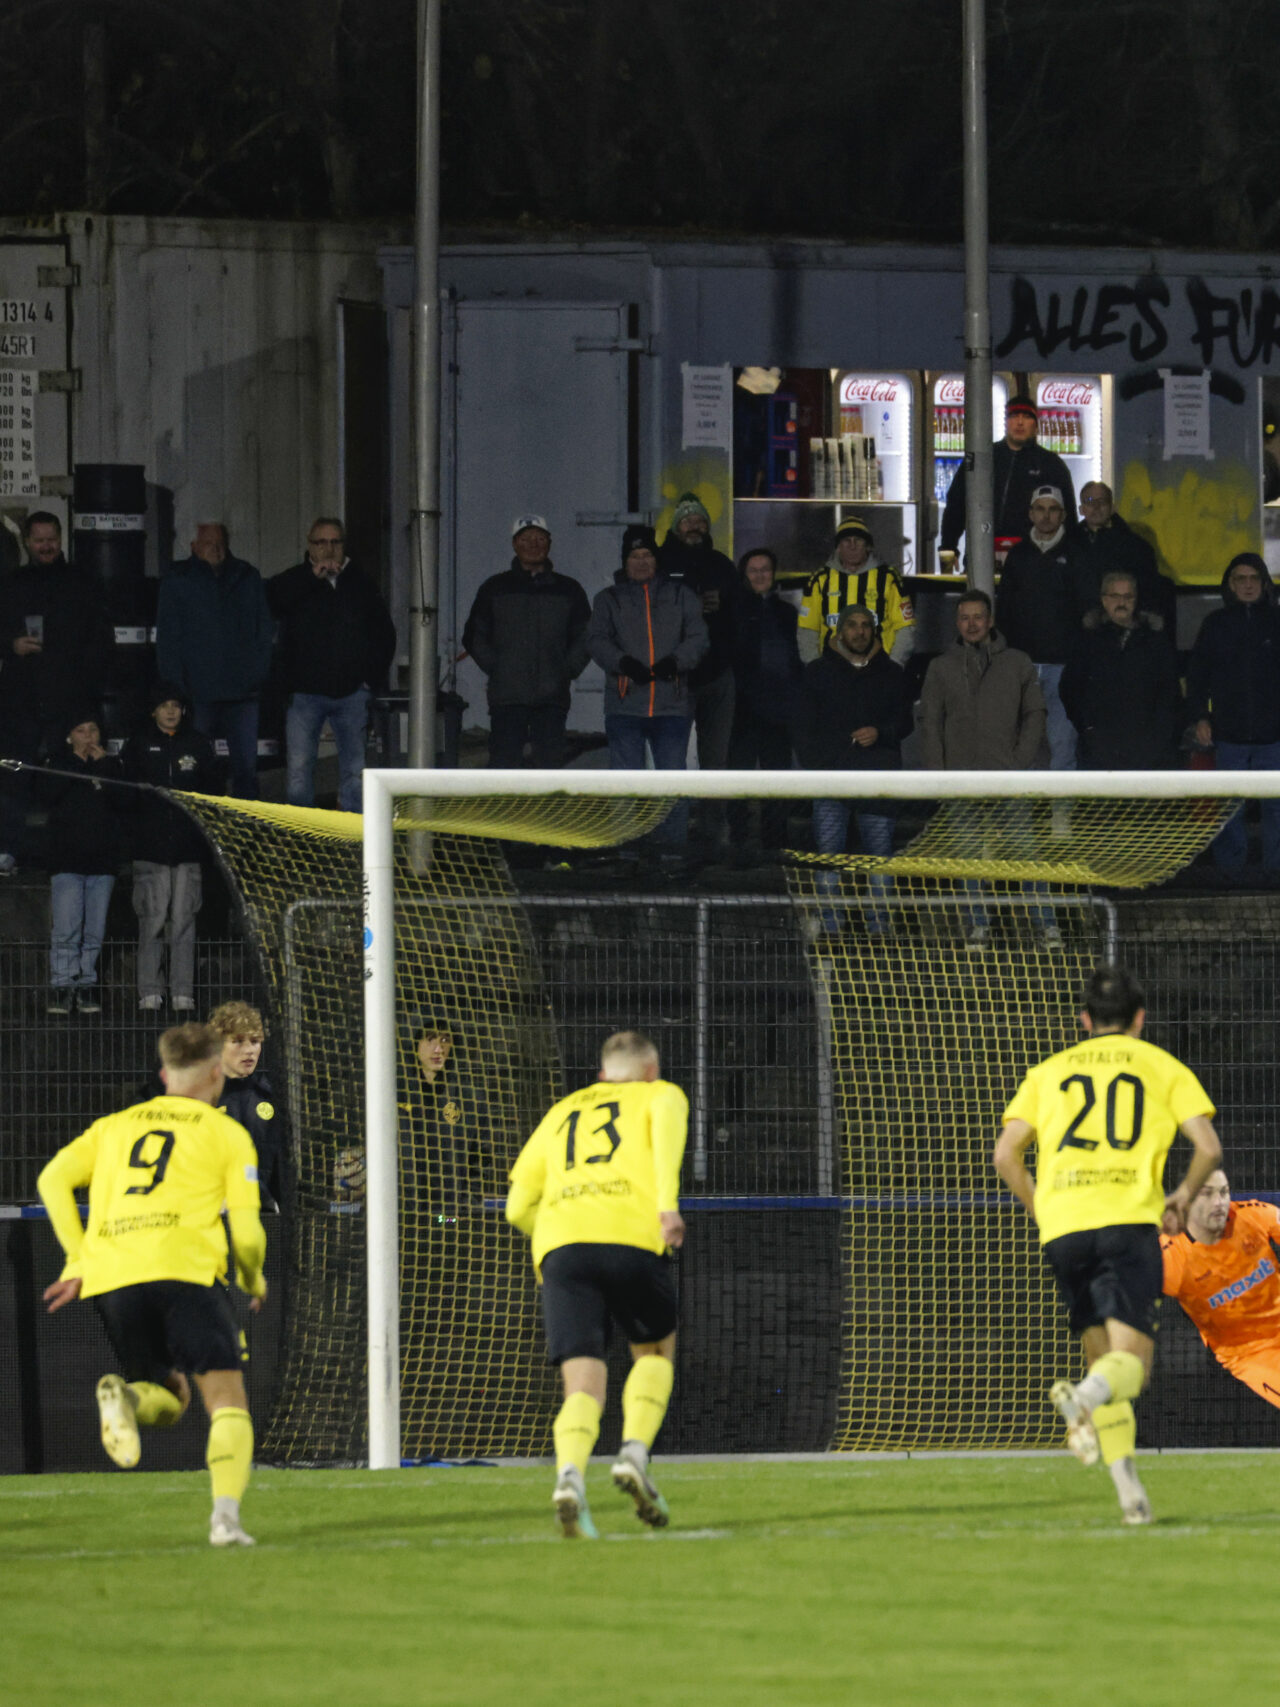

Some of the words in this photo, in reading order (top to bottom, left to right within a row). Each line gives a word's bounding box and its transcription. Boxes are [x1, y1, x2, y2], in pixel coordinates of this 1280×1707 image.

[1, 335, 36, 355] 45R1
[45, 302, 53, 322] 4
[995, 271, 1170, 361] ALLES
[556, 1101, 621, 1171] 13
[1056, 1072, 1145, 1152] 20
[124, 1129, 175, 1195] 9
[1207, 1256, 1276, 1310] maxit
